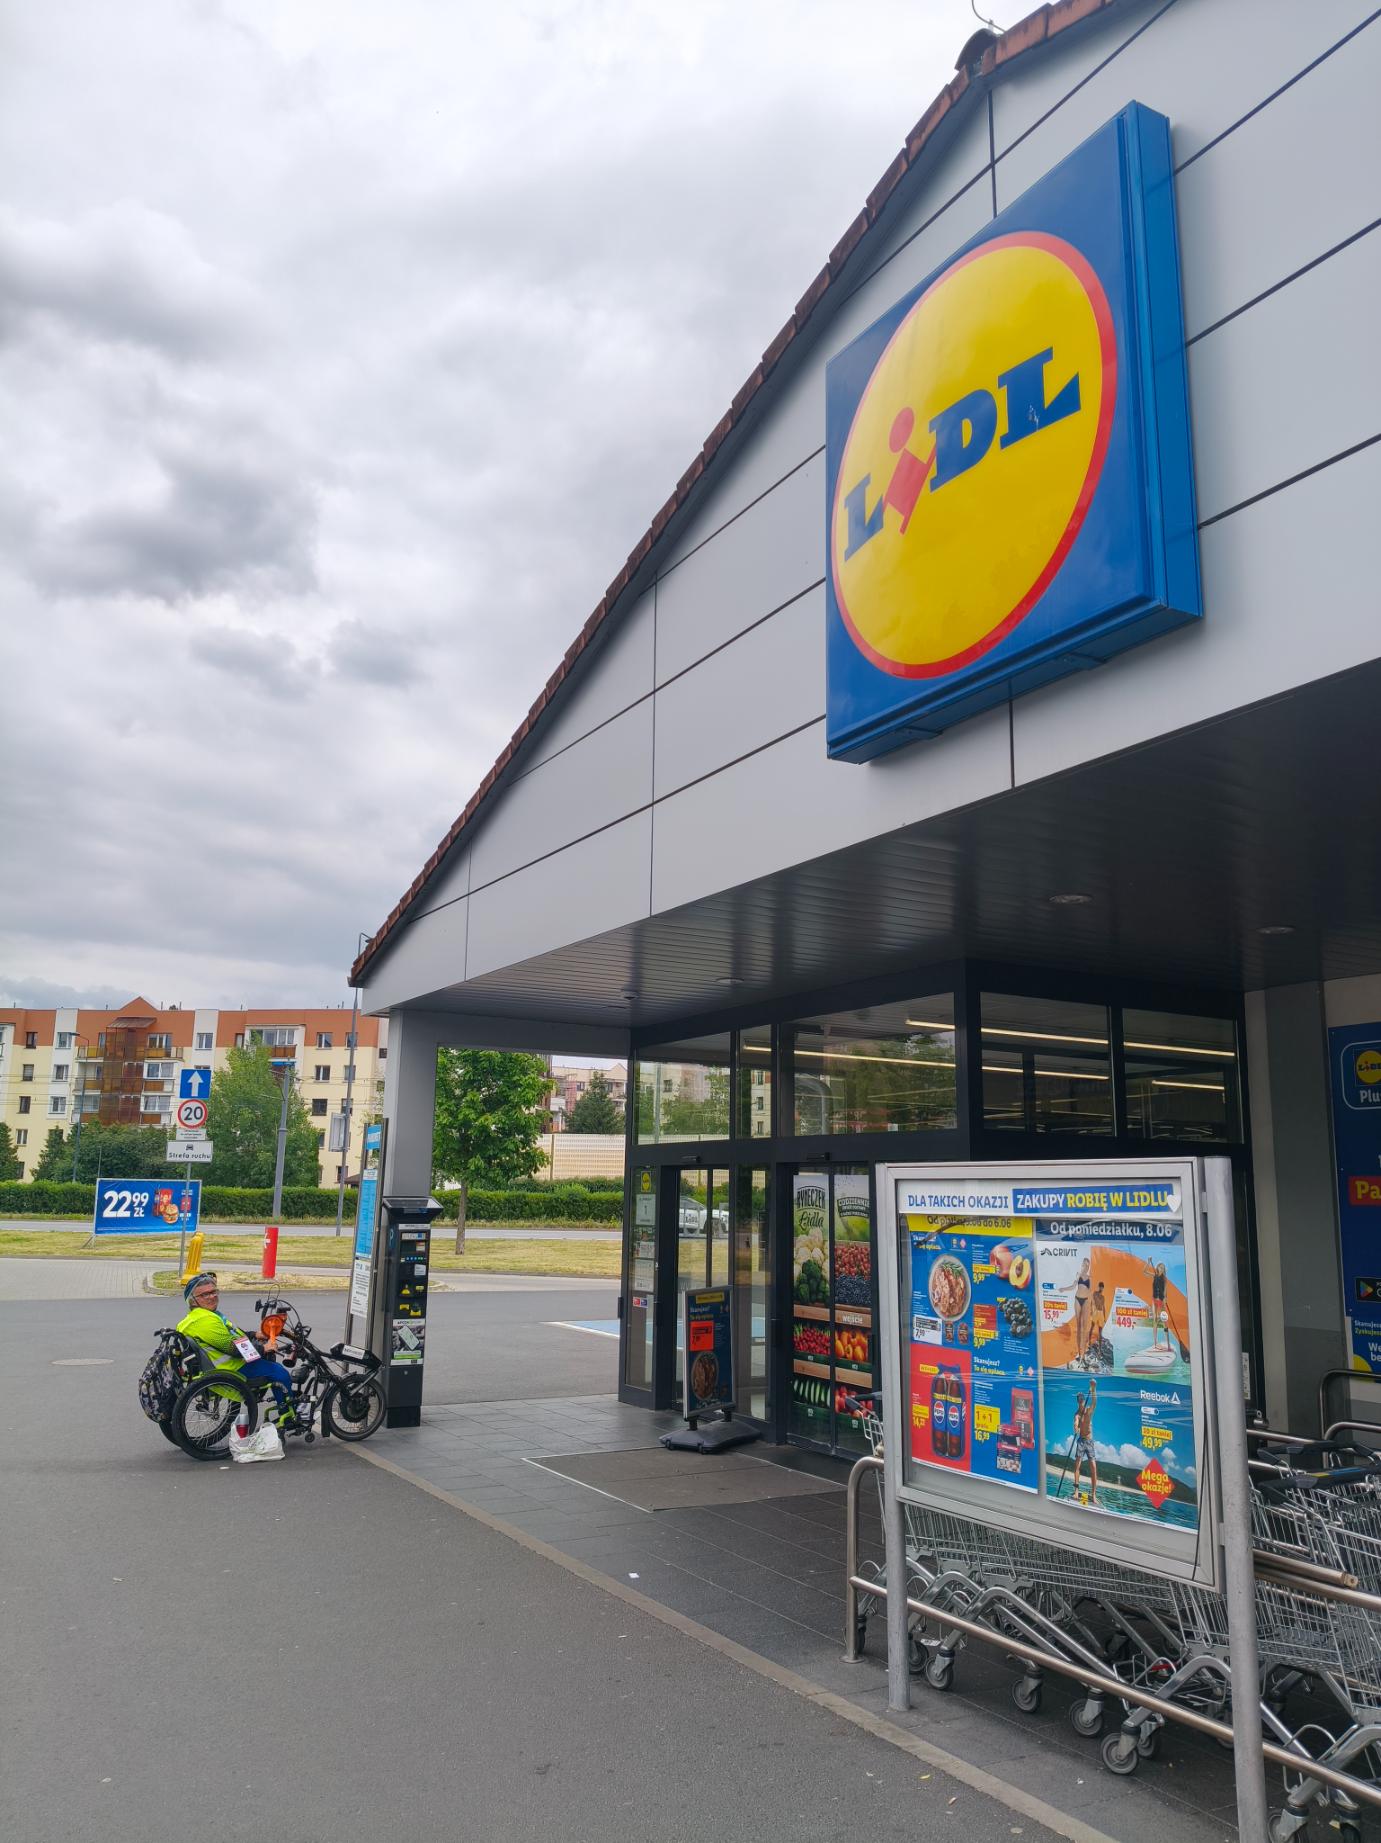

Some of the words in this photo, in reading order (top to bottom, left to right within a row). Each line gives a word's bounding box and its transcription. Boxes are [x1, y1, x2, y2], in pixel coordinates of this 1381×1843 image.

[1360, 1089, 1381, 1104] Plu
[184, 1106, 203, 1121] 20
[1355, 1180, 1381, 1201] Pa
[908, 1195, 926, 1208] DLA
[927, 1194, 965, 1208] TAKICH
[968, 1194, 1009, 1209] OKAZJI
[1017, 1193, 1064, 1209] ZAKUPY
[1066, 1192, 1107, 1211] ROBIĘ
[1109, 1193, 1122, 1207] W
[1126, 1190, 1168, 1207] LIDLU
[799, 1211, 825, 1231] Lidla
[994, 1218, 1011, 1229] 6.06
[1050, 1221, 1066, 1234] Od
[1068, 1221, 1144, 1239] poniedziałku,
[1145, 1224, 1172, 1238] 8.06
[1052, 1248, 1078, 1257] CRIVIT
[1116, 1316, 1136, 1329] 449,-
[1140, 1389, 1169, 1403] Reebok
[1142, 1436, 1163, 1451] 49,99
[1142, 1470, 1168, 1484] Mega
[1142, 1481, 1171, 1494] okazje!
